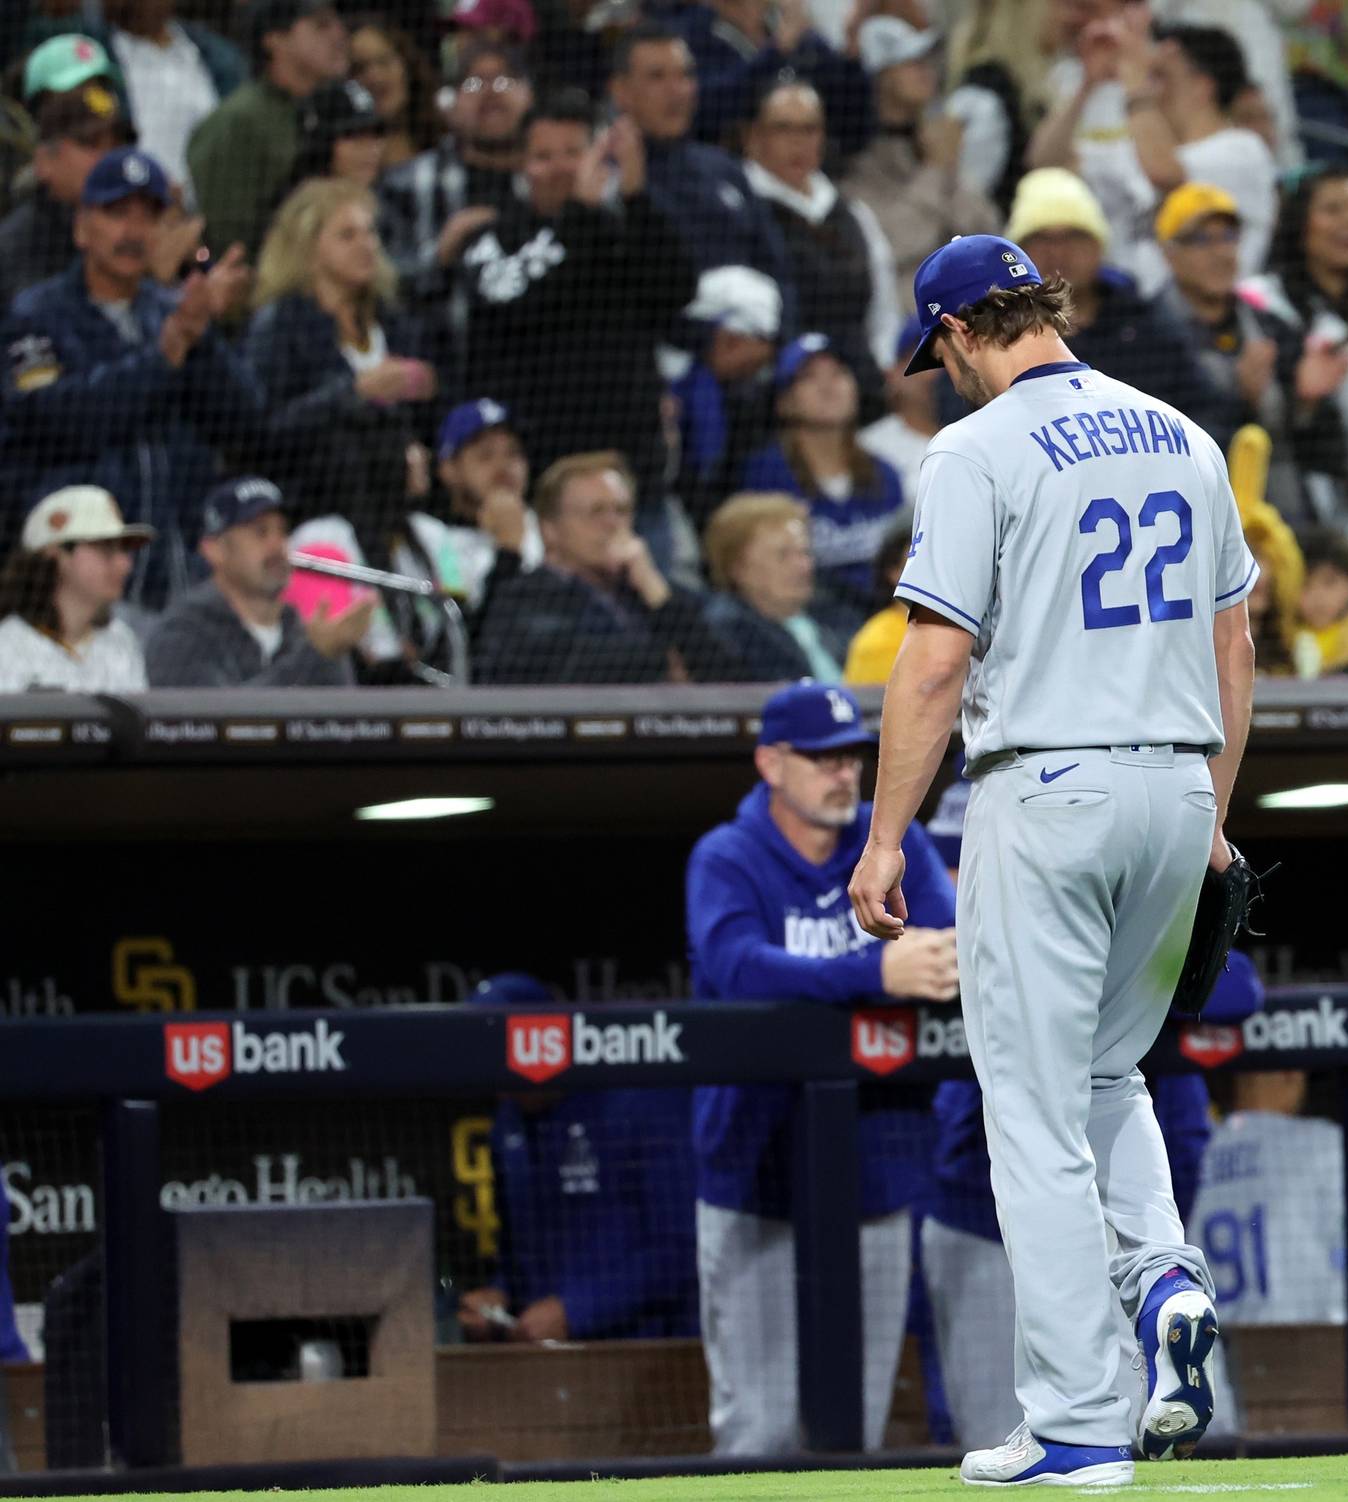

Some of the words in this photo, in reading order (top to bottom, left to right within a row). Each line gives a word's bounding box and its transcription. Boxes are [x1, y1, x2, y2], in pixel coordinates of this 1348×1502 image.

[1030, 408, 1191, 472] KERSHAW
[1079, 490, 1193, 630] 22
[171, 1034, 226, 1074] us
[232, 1018, 346, 1074] bank
[513, 1026, 566, 1066] us
[573, 1010, 684, 1066] bank
[917, 1006, 969, 1058] ba
[1204, 1203, 1270, 1305] 91
